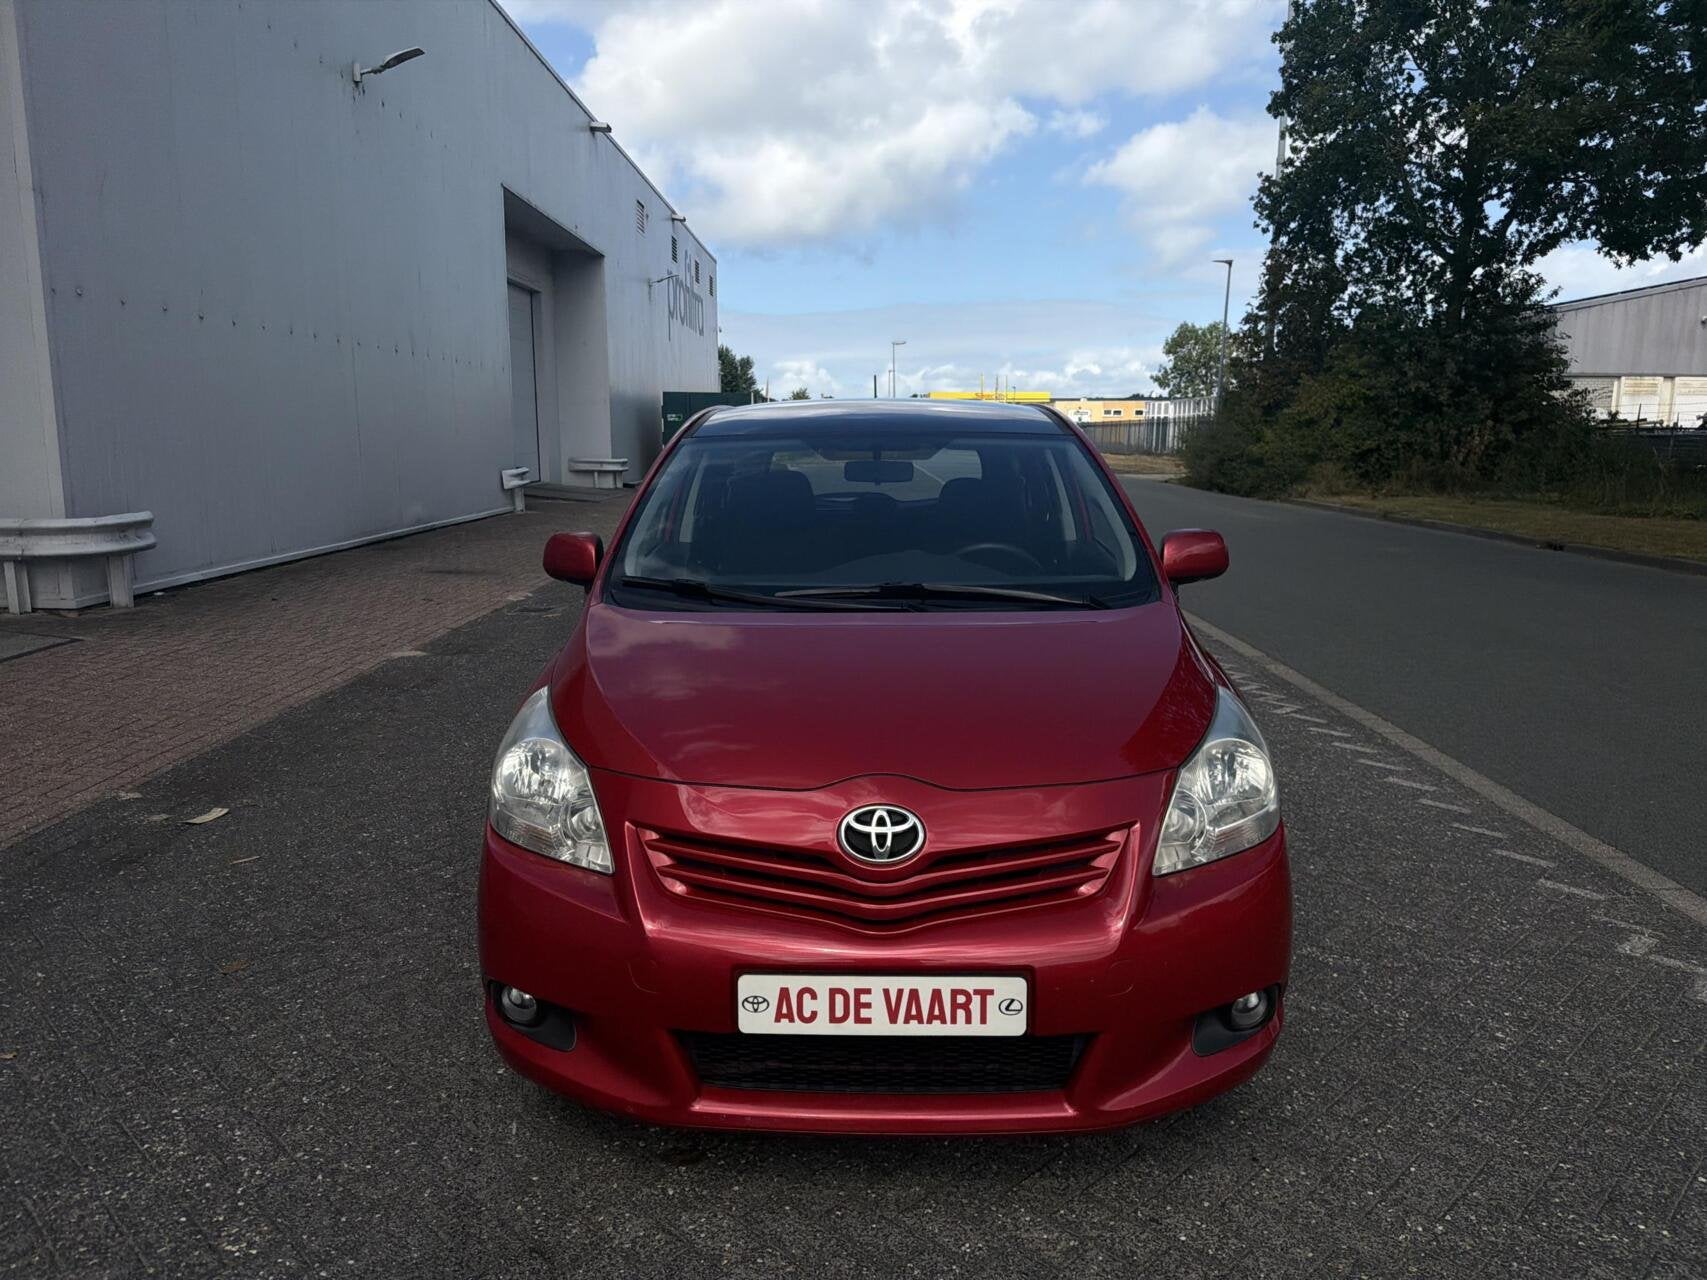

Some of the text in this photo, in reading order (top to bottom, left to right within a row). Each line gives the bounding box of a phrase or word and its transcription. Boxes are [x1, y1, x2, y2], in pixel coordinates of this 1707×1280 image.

[774, 987, 995, 1025] AC DE VAART
